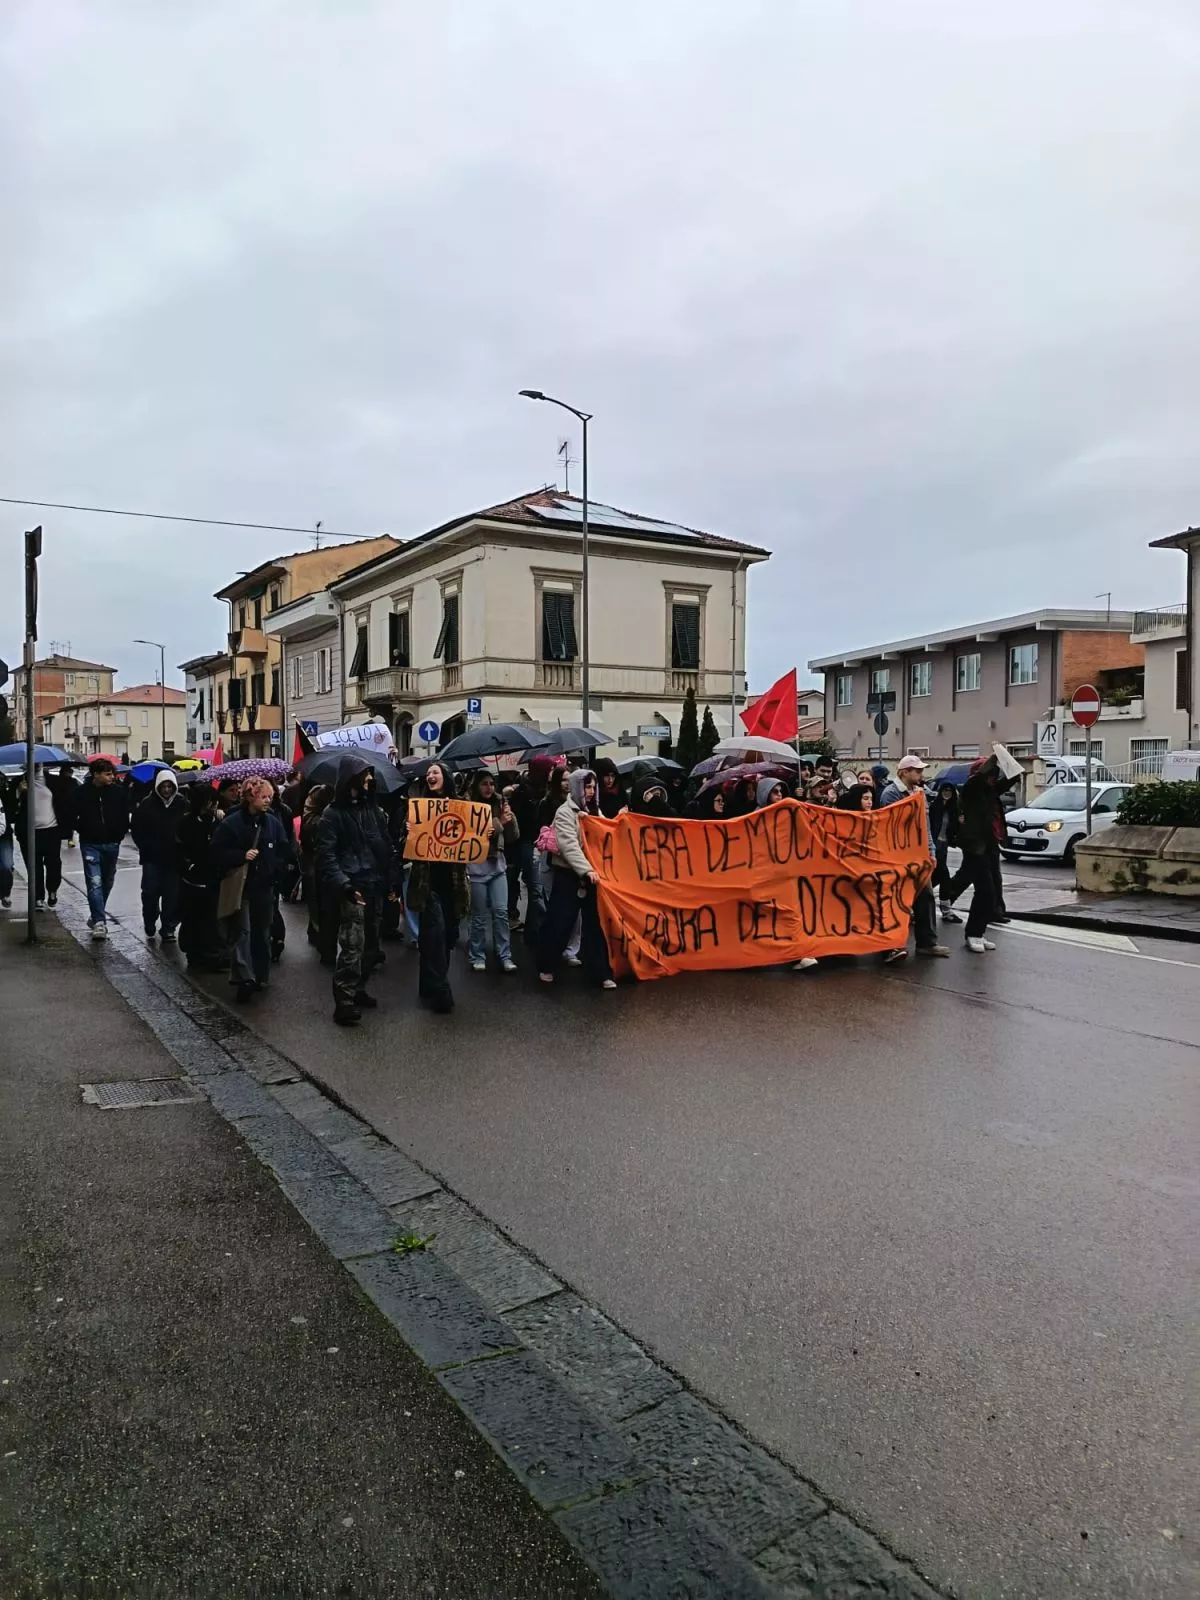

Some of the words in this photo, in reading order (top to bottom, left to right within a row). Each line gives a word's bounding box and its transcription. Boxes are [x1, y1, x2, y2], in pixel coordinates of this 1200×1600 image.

[470, 699, 479, 711] P
[331, 728, 355, 744] ICE
[412, 800, 421, 824] I
[471, 804, 491, 837] MY
[439, 819, 460, 838] ICE
[415, 832, 482, 861] CRUSHED
[628, 822, 693, 881] VERA
[886, 799, 922, 852] NON
[738, 898, 792, 942] DEL
